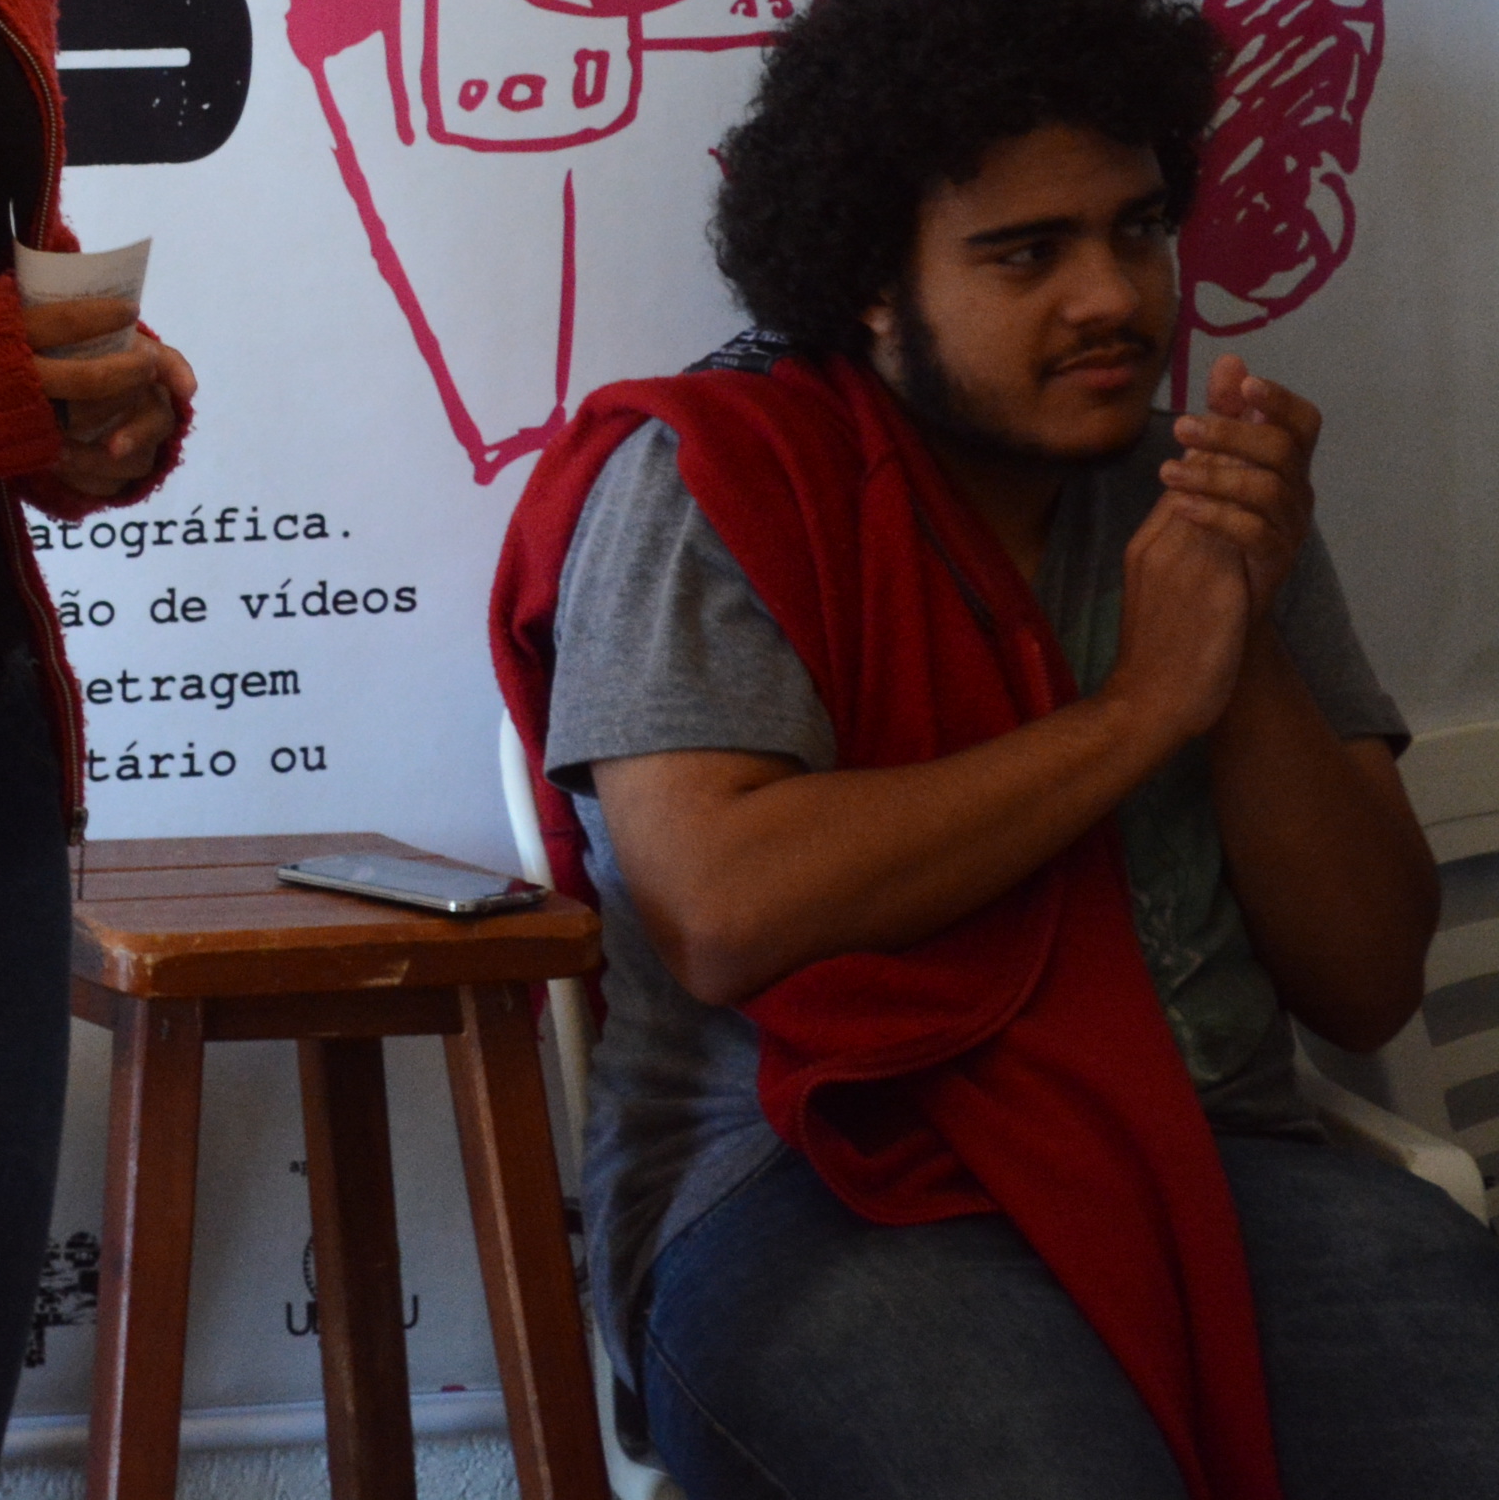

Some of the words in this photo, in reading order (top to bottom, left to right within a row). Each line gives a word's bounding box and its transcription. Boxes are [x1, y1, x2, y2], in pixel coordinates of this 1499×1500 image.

[29, 505, 351, 558] atográfica.
[149, 588, 208, 624] de
[240, 577, 418, 620] vídeos
[86, 668, 301, 710] etragem
[88, 741, 237, 782] tário
[270, 744, 328, 775] ou
